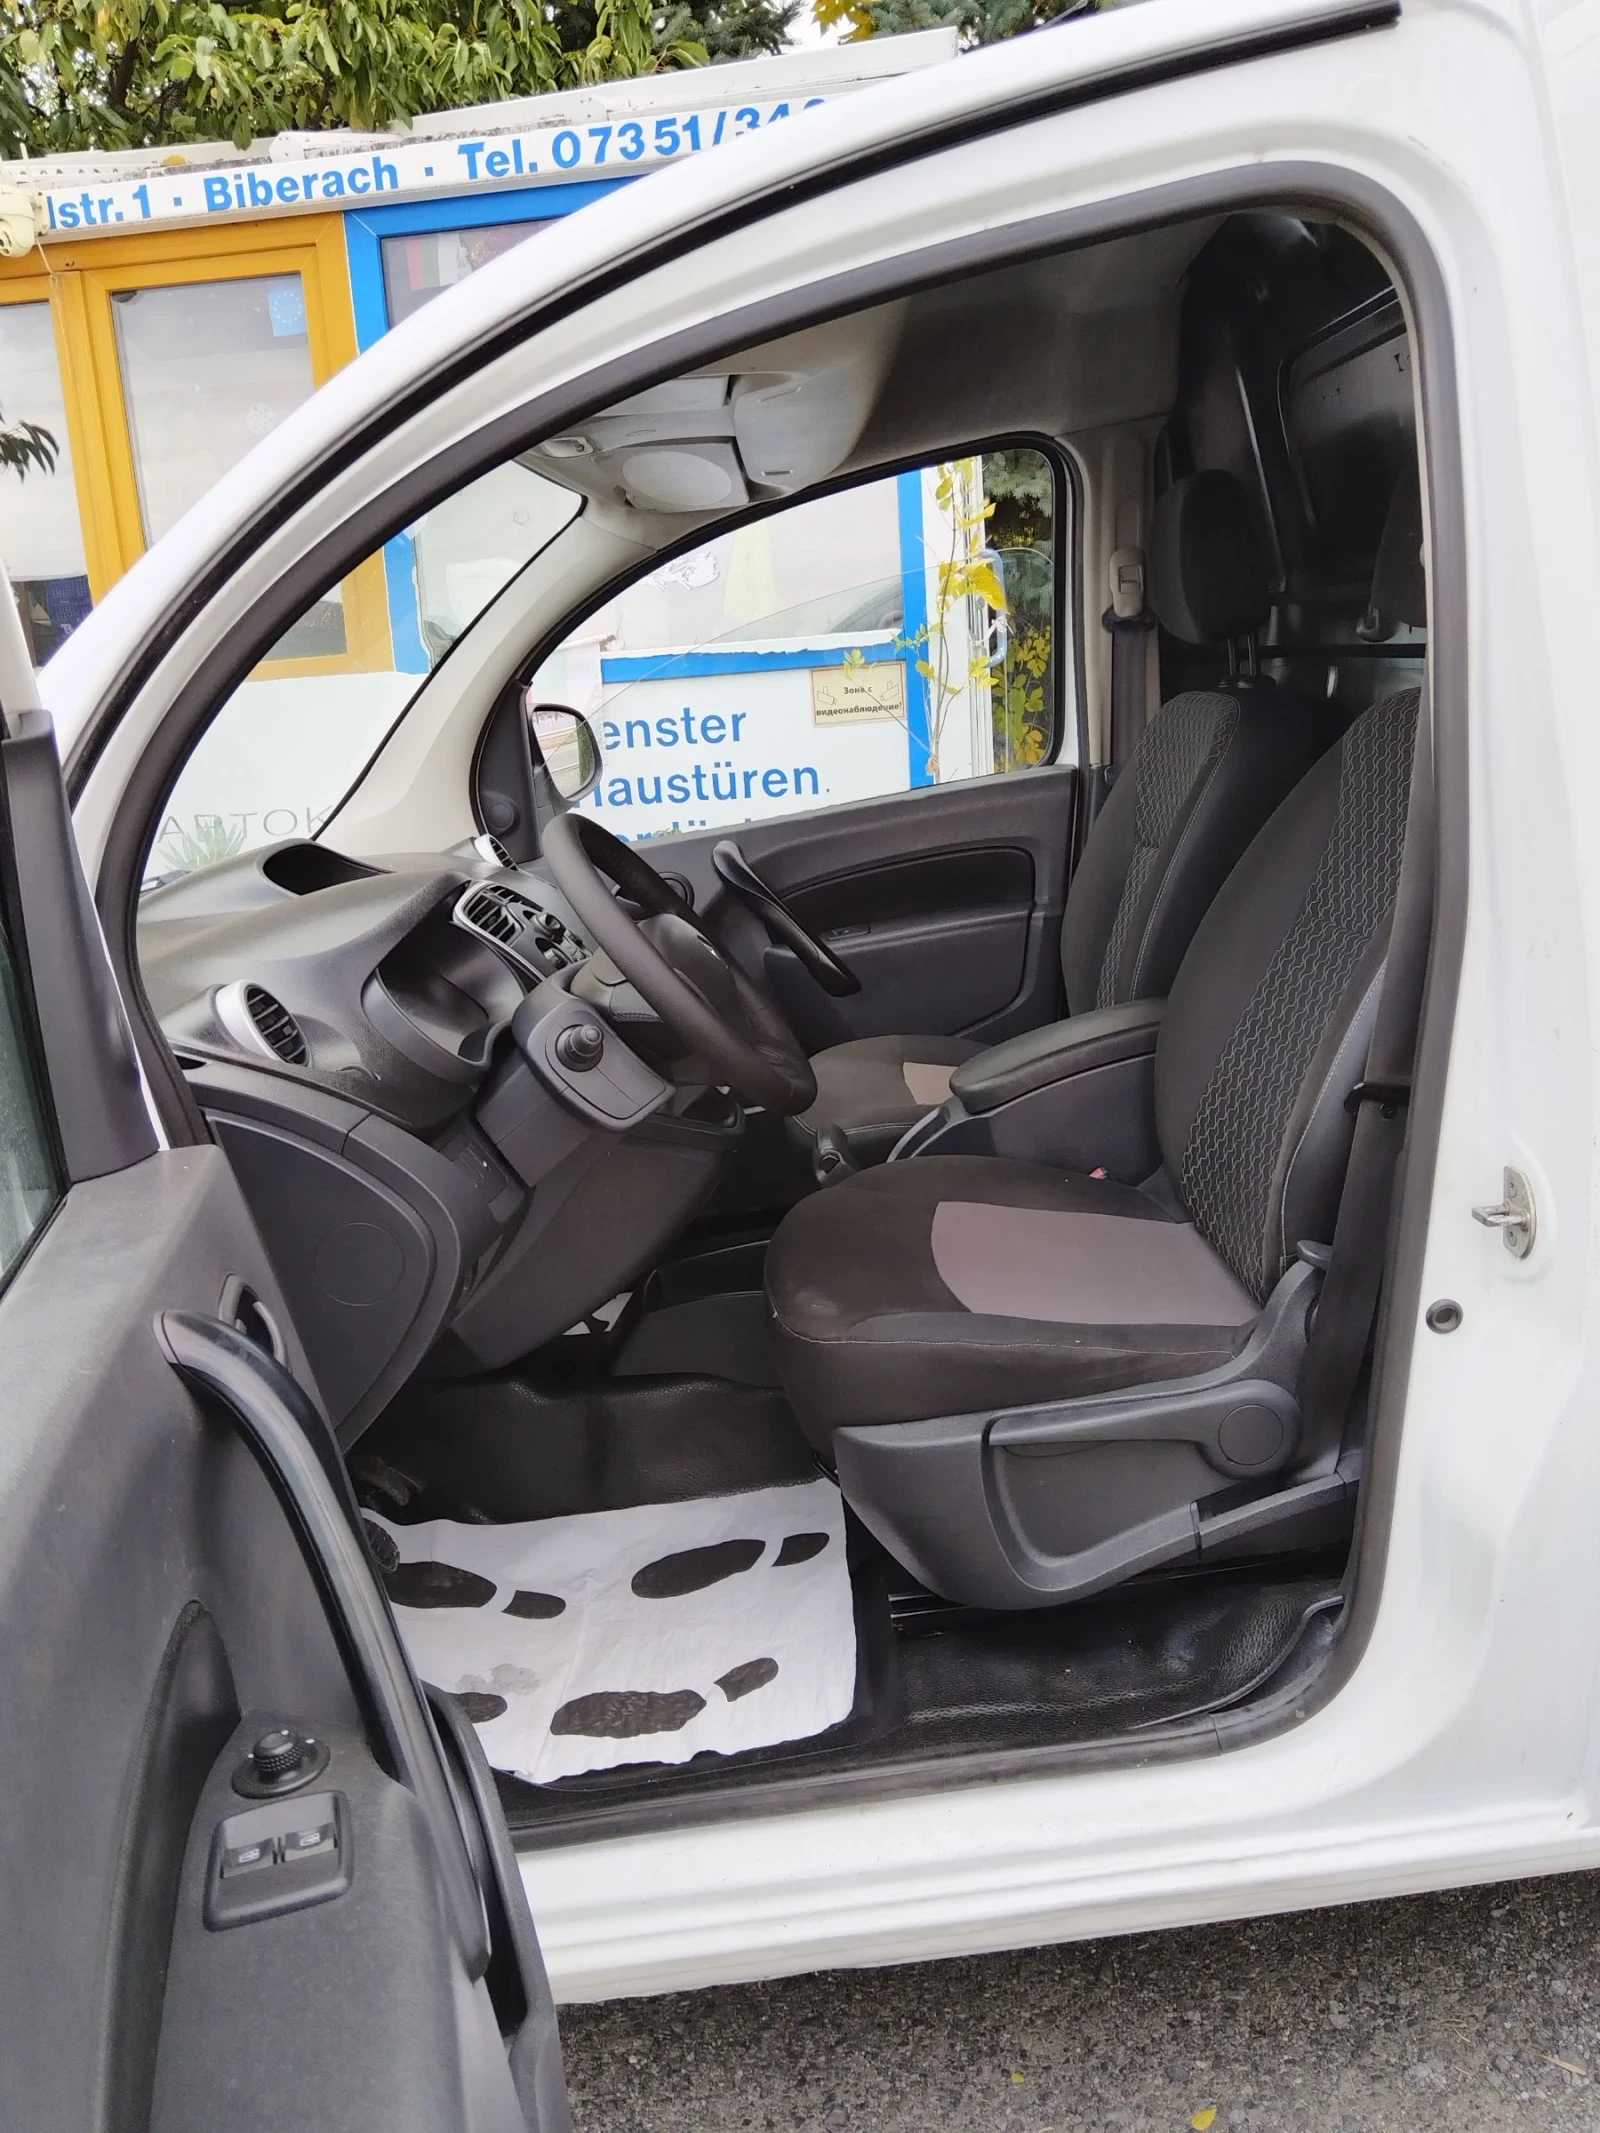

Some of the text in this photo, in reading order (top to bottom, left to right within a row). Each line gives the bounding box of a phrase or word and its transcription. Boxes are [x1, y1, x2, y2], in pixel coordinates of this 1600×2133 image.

[132, 184, 152, 219] 1
[203, 156, 399, 213] Biberach
[457, 138, 539, 180] Tel.
[843, 686, 865, 695] Зона
[816, 701, 902, 717] видеонаблюдение!
